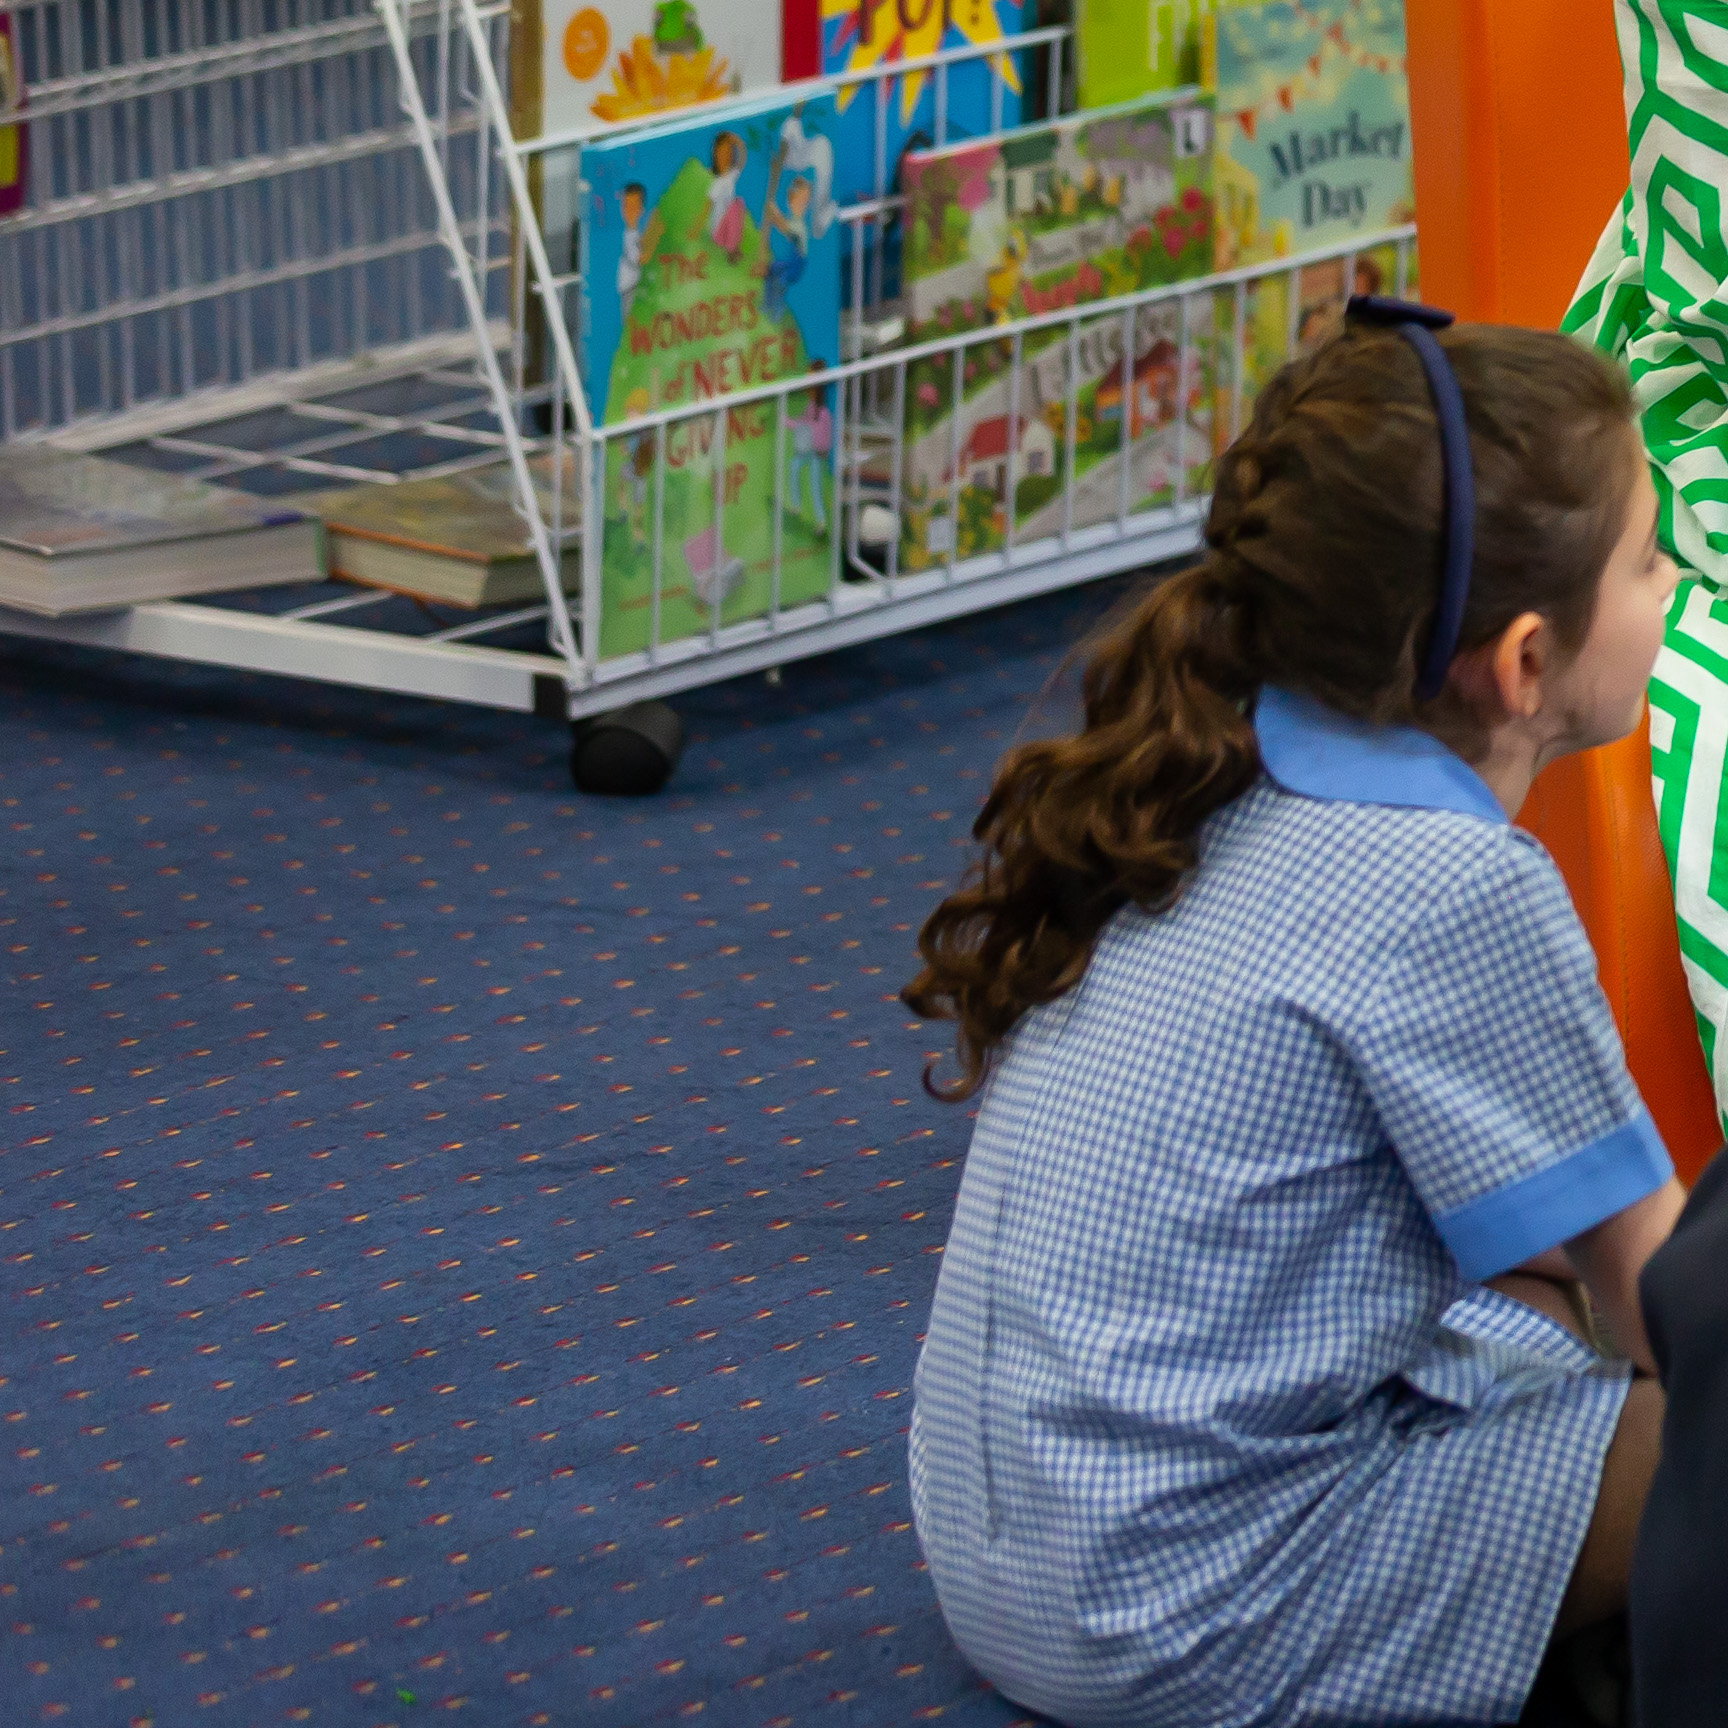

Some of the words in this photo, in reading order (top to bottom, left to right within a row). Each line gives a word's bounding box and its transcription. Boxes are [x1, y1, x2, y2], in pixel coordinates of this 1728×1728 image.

[1268, 110, 1406, 183] Market
[1299, 178, 1371, 229] Day
[627, 289, 759, 366] WONDERS
[692, 328, 799, 402] NEVER
[665, 400, 767, 470] GIVNG
